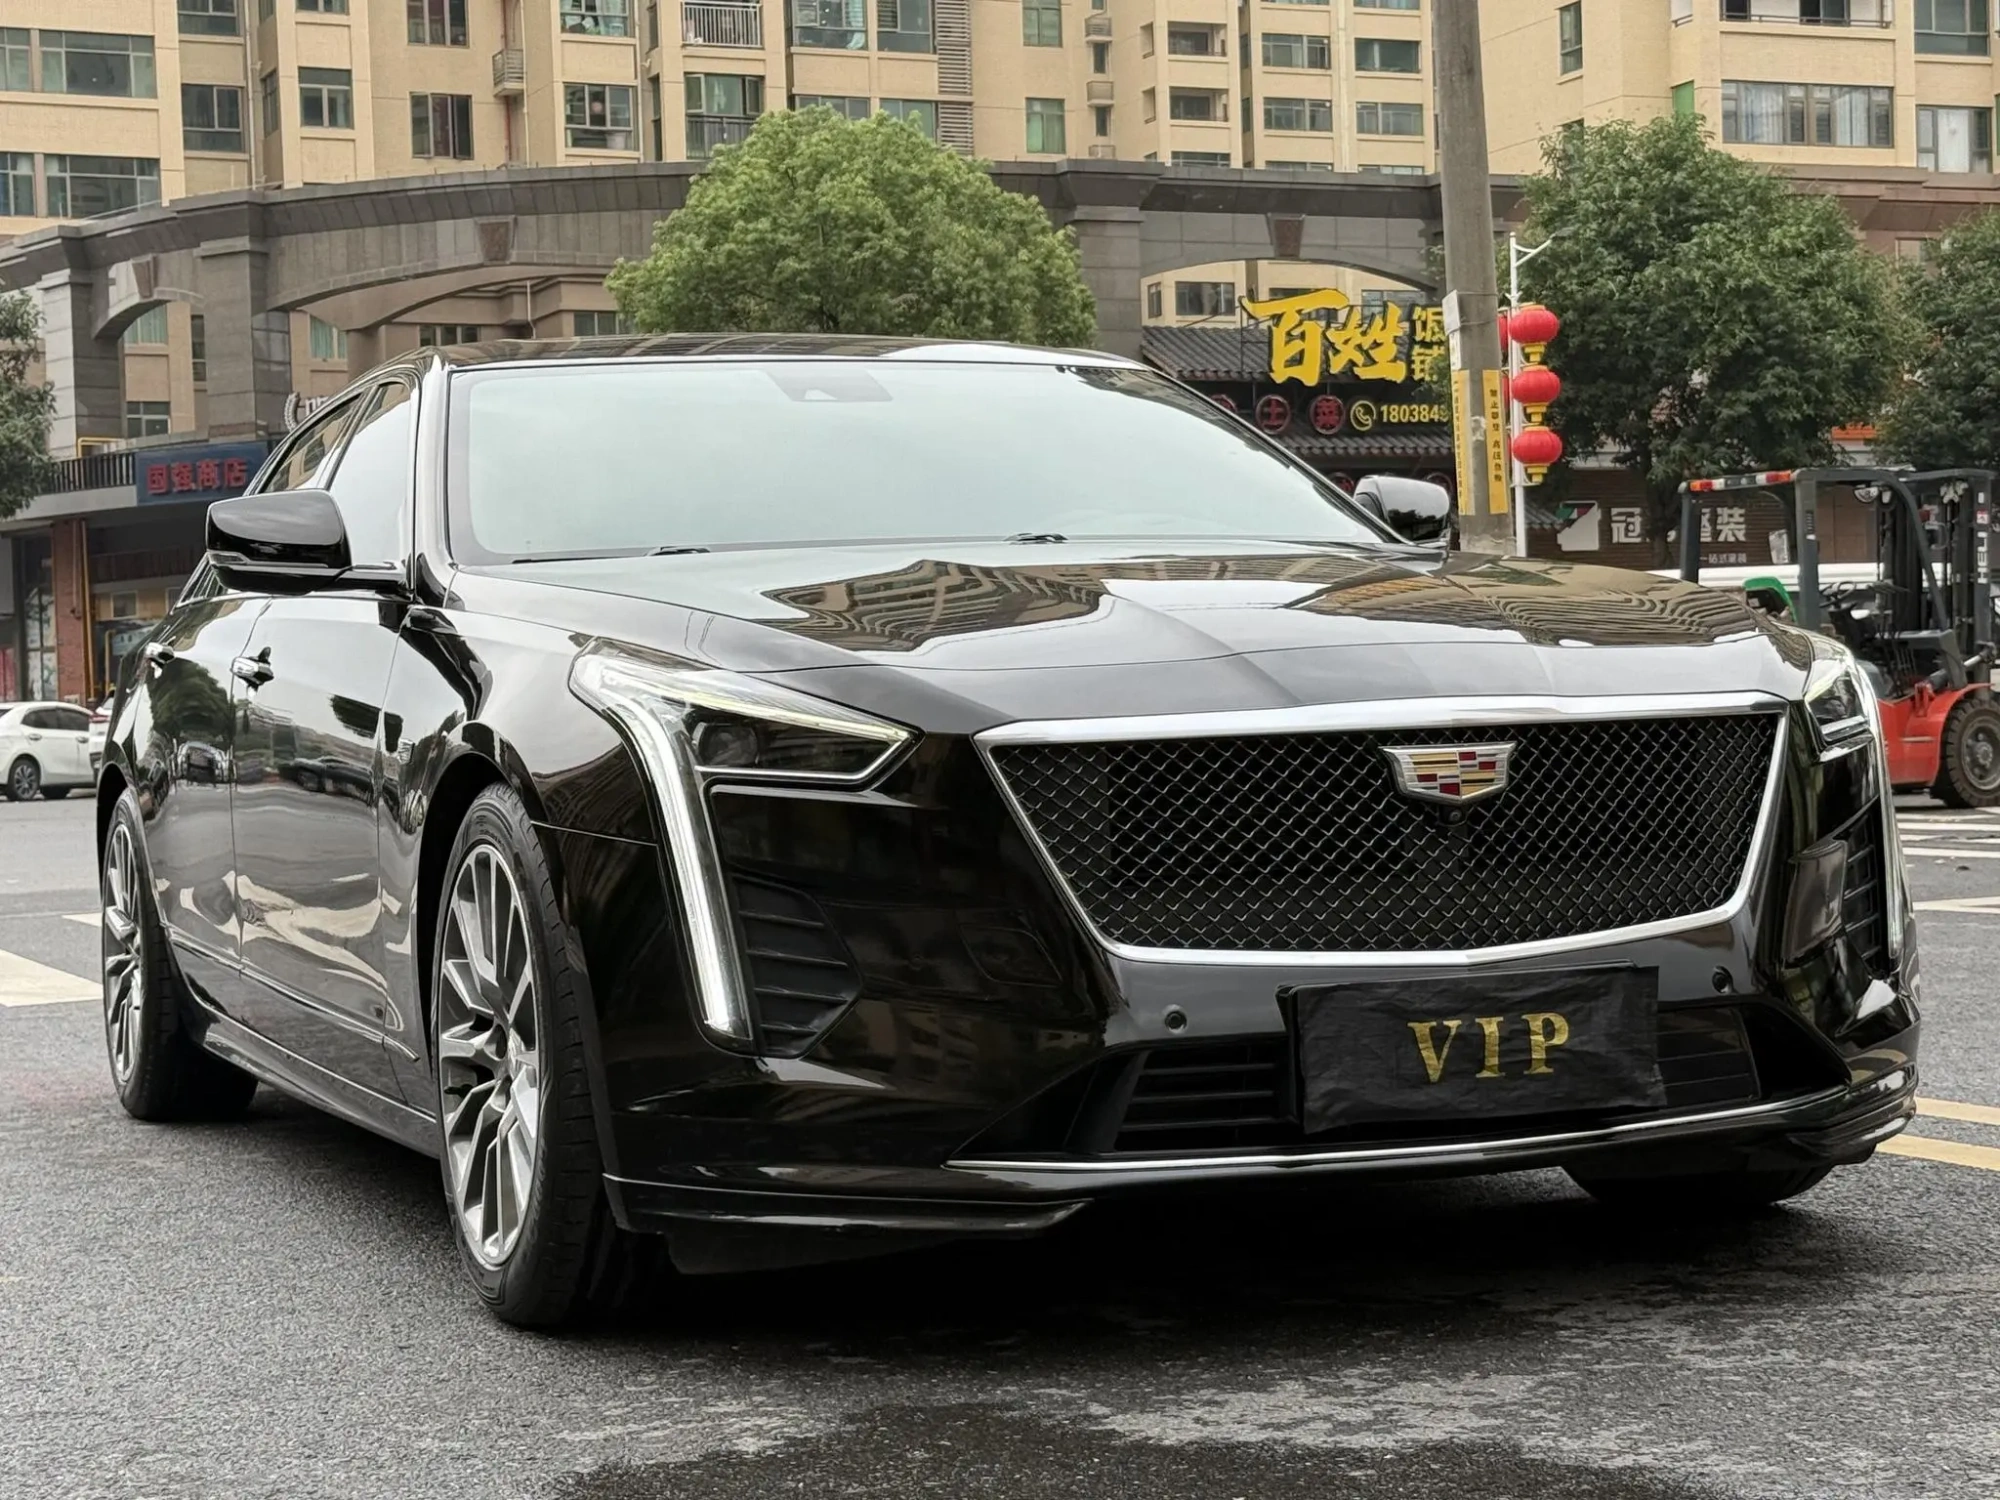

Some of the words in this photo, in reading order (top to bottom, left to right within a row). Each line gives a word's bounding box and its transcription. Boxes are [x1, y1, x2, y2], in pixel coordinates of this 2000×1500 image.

[1239, 288, 1407, 386] 百姓
[147, 456, 248, 494] 国强商店
[1977, 531, 1988, 584] HELI
[1407, 1012, 1569, 1083] VIP
